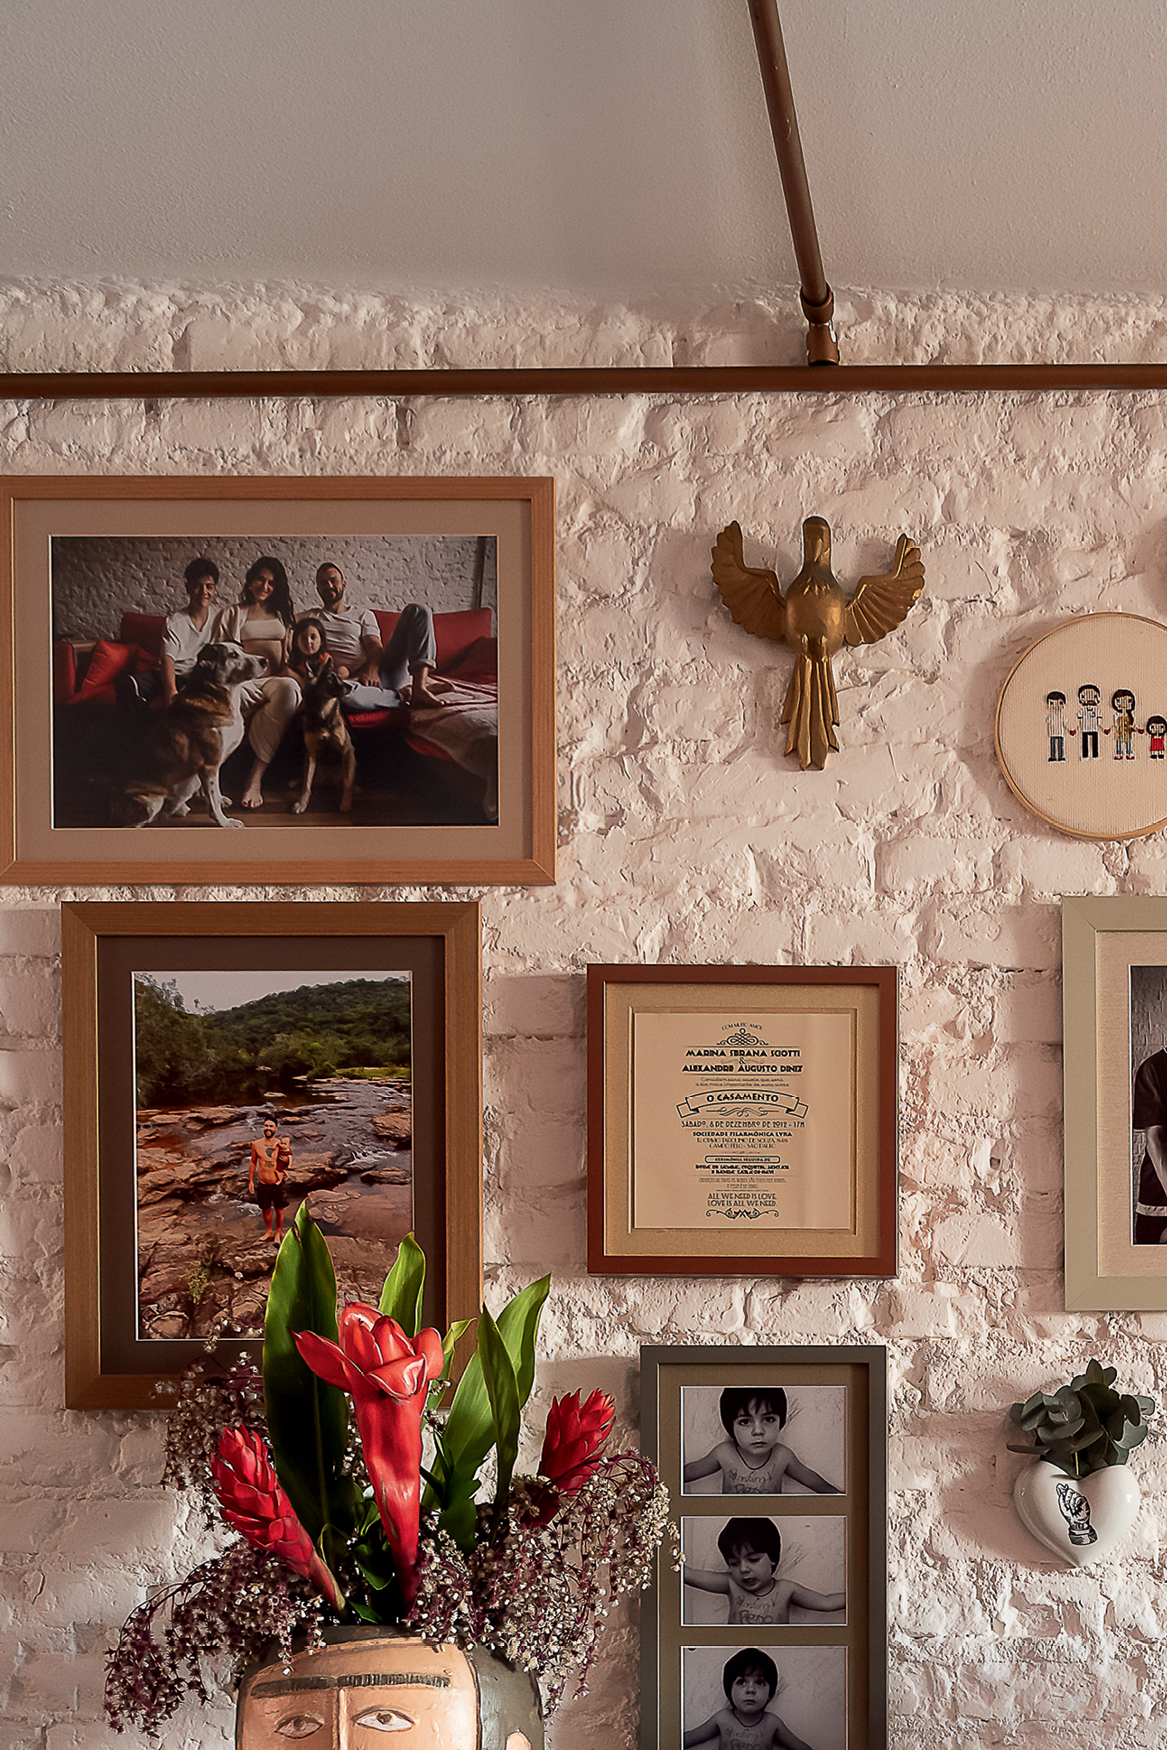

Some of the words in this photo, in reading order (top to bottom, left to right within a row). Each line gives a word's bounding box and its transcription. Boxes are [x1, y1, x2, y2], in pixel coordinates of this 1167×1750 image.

[685, 1049, 727, 1057] MARINA
[738, 1056, 747, 1064] &
[682, 1064, 734, 1072] ALEXANDRE
[738, 1064, 778, 1072] AUGUSTO
[780, 1064, 803, 1072] DINIZ
[706, 1094, 715, 1103] O
[717, 1093, 779, 1102] CASAMENTO
